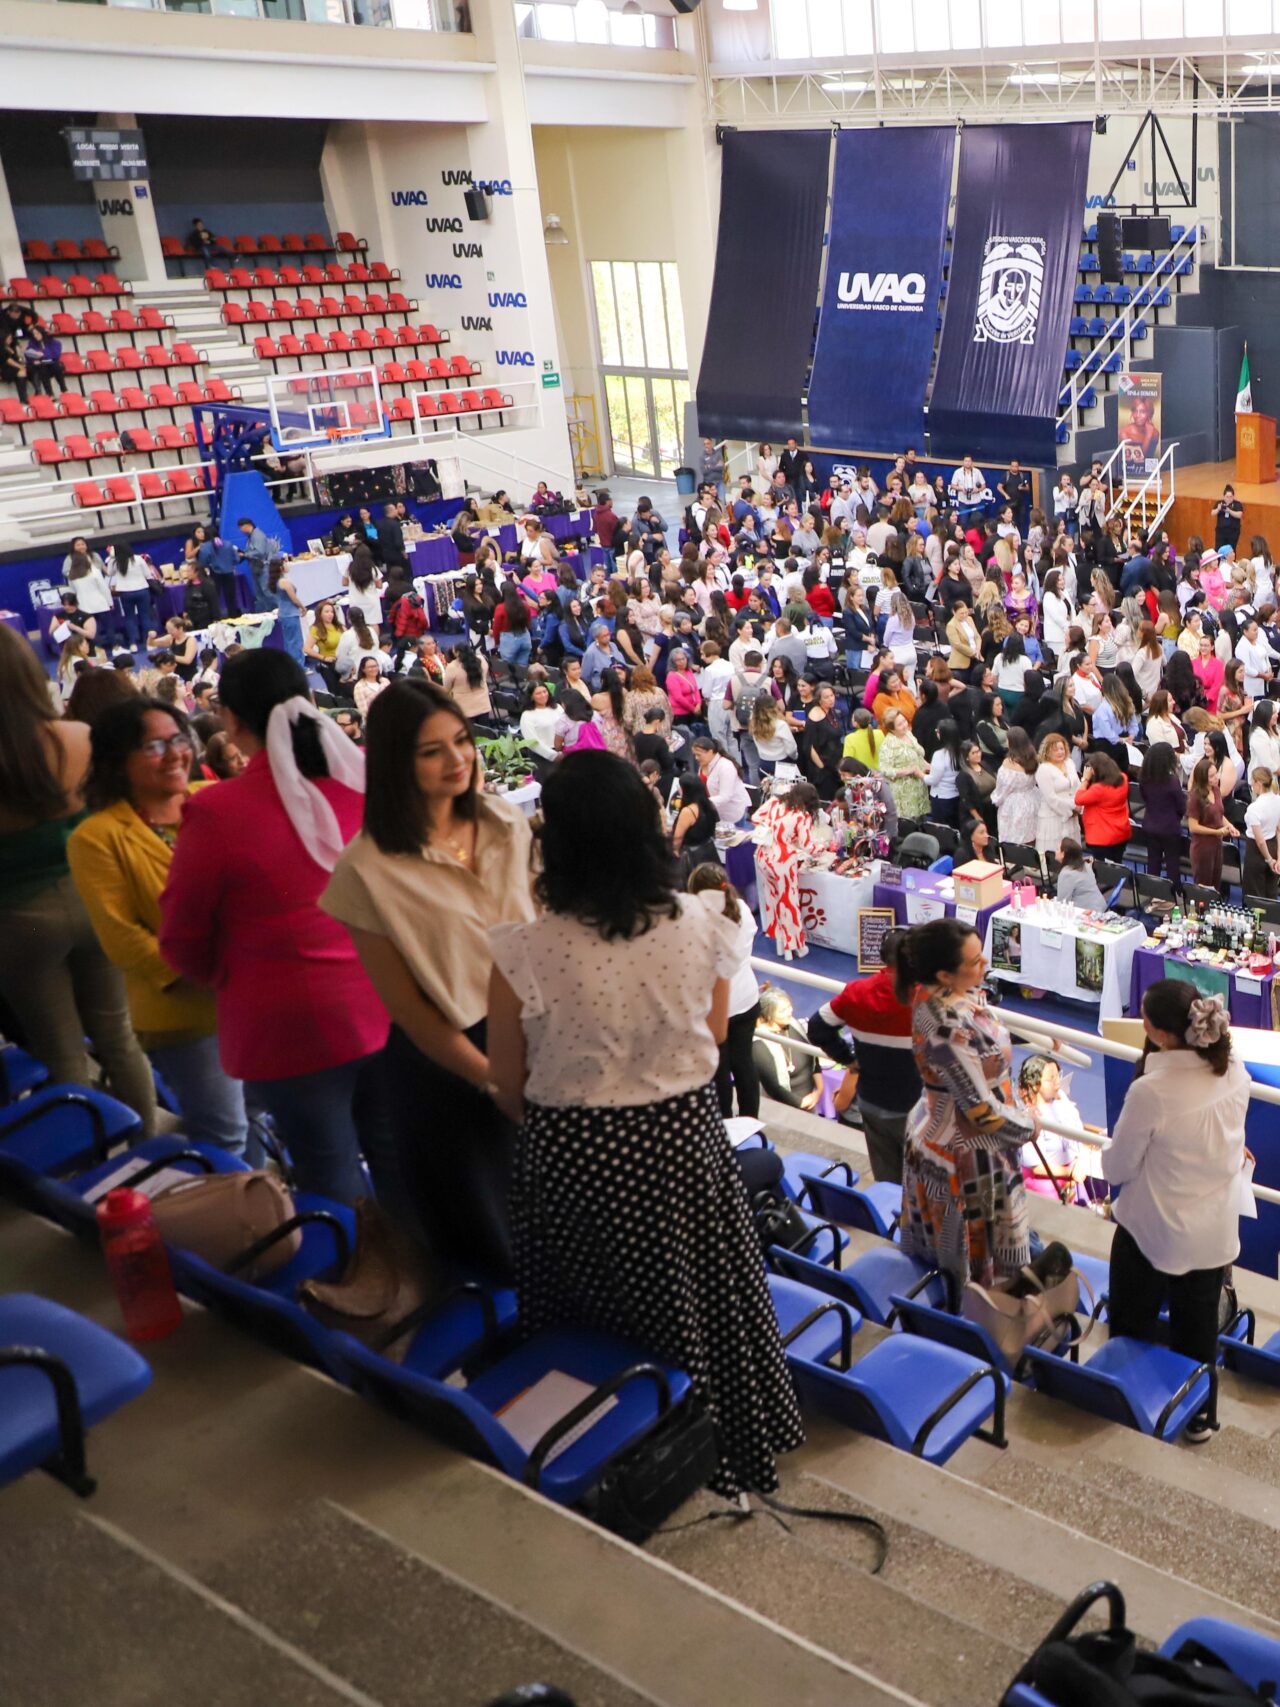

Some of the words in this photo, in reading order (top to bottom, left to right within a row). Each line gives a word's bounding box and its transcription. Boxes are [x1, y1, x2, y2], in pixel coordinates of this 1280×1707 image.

[391, 190, 428, 206] UVAQ
[1085, 195, 1116, 208] VAQ
[99, 199, 134, 216] UVAQ
[426, 218, 463, 233] UVAQ
[453, 243, 483, 258] UVA
[426, 274, 462, 288] UVAQ
[838, 272, 926, 303] UVAQ
[488, 292, 527, 307] UVAQ
[461, 316, 493, 331] UVA
[496, 350, 535, 366] UVAQ
